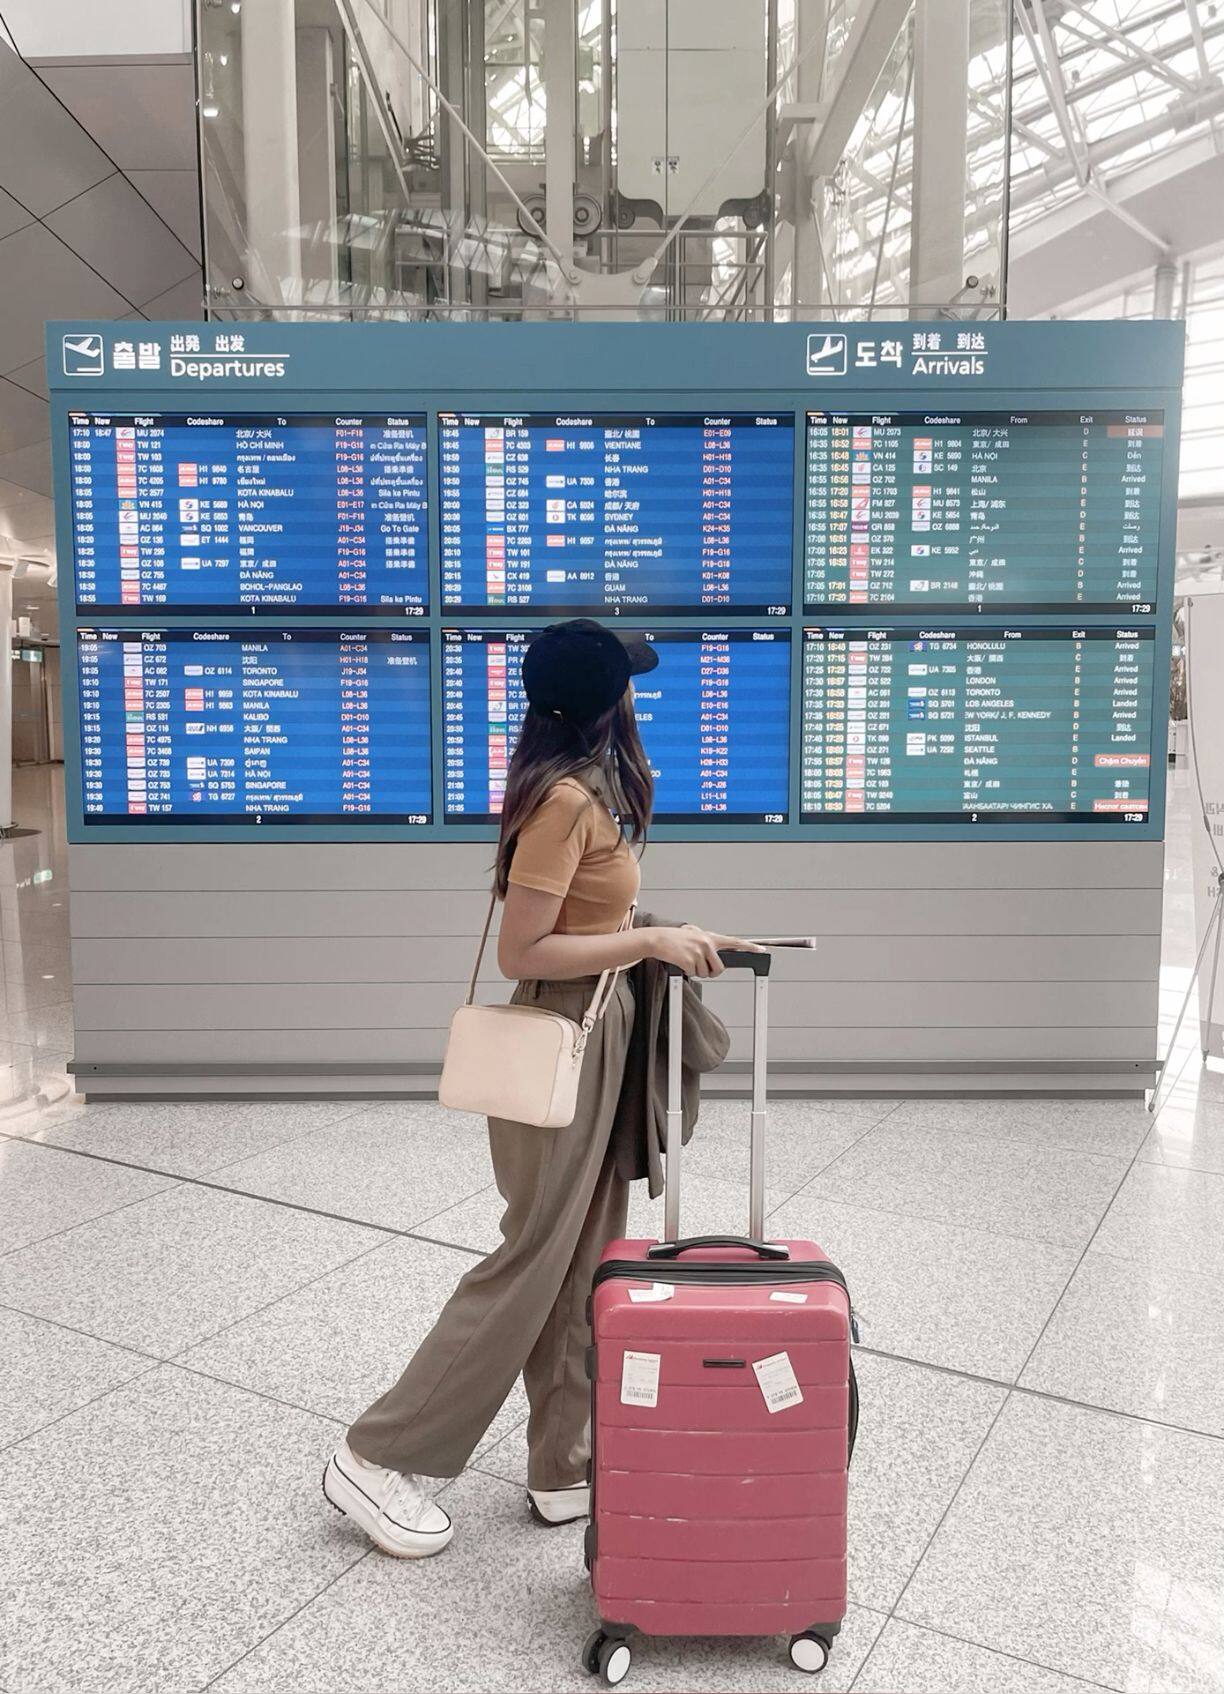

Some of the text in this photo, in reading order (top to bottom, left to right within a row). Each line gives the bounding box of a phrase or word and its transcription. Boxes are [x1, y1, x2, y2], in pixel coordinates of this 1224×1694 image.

[170, 335, 245, 352] 出発 出发
[913, 333, 985, 350] 到着 到达
[113, 341, 161, 370] 출발
[855, 341, 903, 368] 도착
[170, 359, 285, 381] Departures
[912, 357, 984, 375] Arrivals
[134, 417, 154, 427] Flight
[277, 418, 287, 426] To
[335, 418, 362, 426] Counter
[387, 418, 409, 426] Status
[442, 418, 459, 426] Time
[504, 418, 523, 427] Flight
[556, 418, 593, 426] Codeshare
[645, 417, 655, 426] To
[704, 418, 731, 426] Counter
[755, 418, 777, 426] Status
[872, 416, 891, 425] Flight
[924, 416, 961, 424] Codeshare
[1010, 416, 1028, 424] From
[1080, 416, 1093, 424] Exit
[1125, 416, 1147, 424] Status
[622, 465, 649, 473] TRANG
[1121, 475, 1146, 483] Arrived
[237, 489, 257, 497] KOTA
[239, 524, 283, 532] VANCOUVER
[1118, 546, 1143, 554] Arrived
[1116, 593, 1141, 601] Arrived
[142, 633, 161, 642] Flight
[282, 633, 292, 641] To
[340, 633, 367, 641] Counter
[391, 633, 413, 641] Status
[506, 634, 525, 643] Flight
[645, 633, 654, 641] To
[702, 633, 729, 641] Counter
[753, 633, 774, 641] Status
[867, 632, 887, 641] Flight
[1073, 631, 1086, 639] Exit
[967, 642, 1006, 650] HONOLULU
[1115, 642, 1139, 650] Arrived
[242, 667, 277, 675] TORONTO
[1114, 665, 1138, 673] Arrived
[966, 688, 1001, 696] TORONTO
[1113, 699, 1137, 707] Landed
[1017, 711, 1051, 719] KENNEDY
[1111, 734, 1136, 742] Landed
